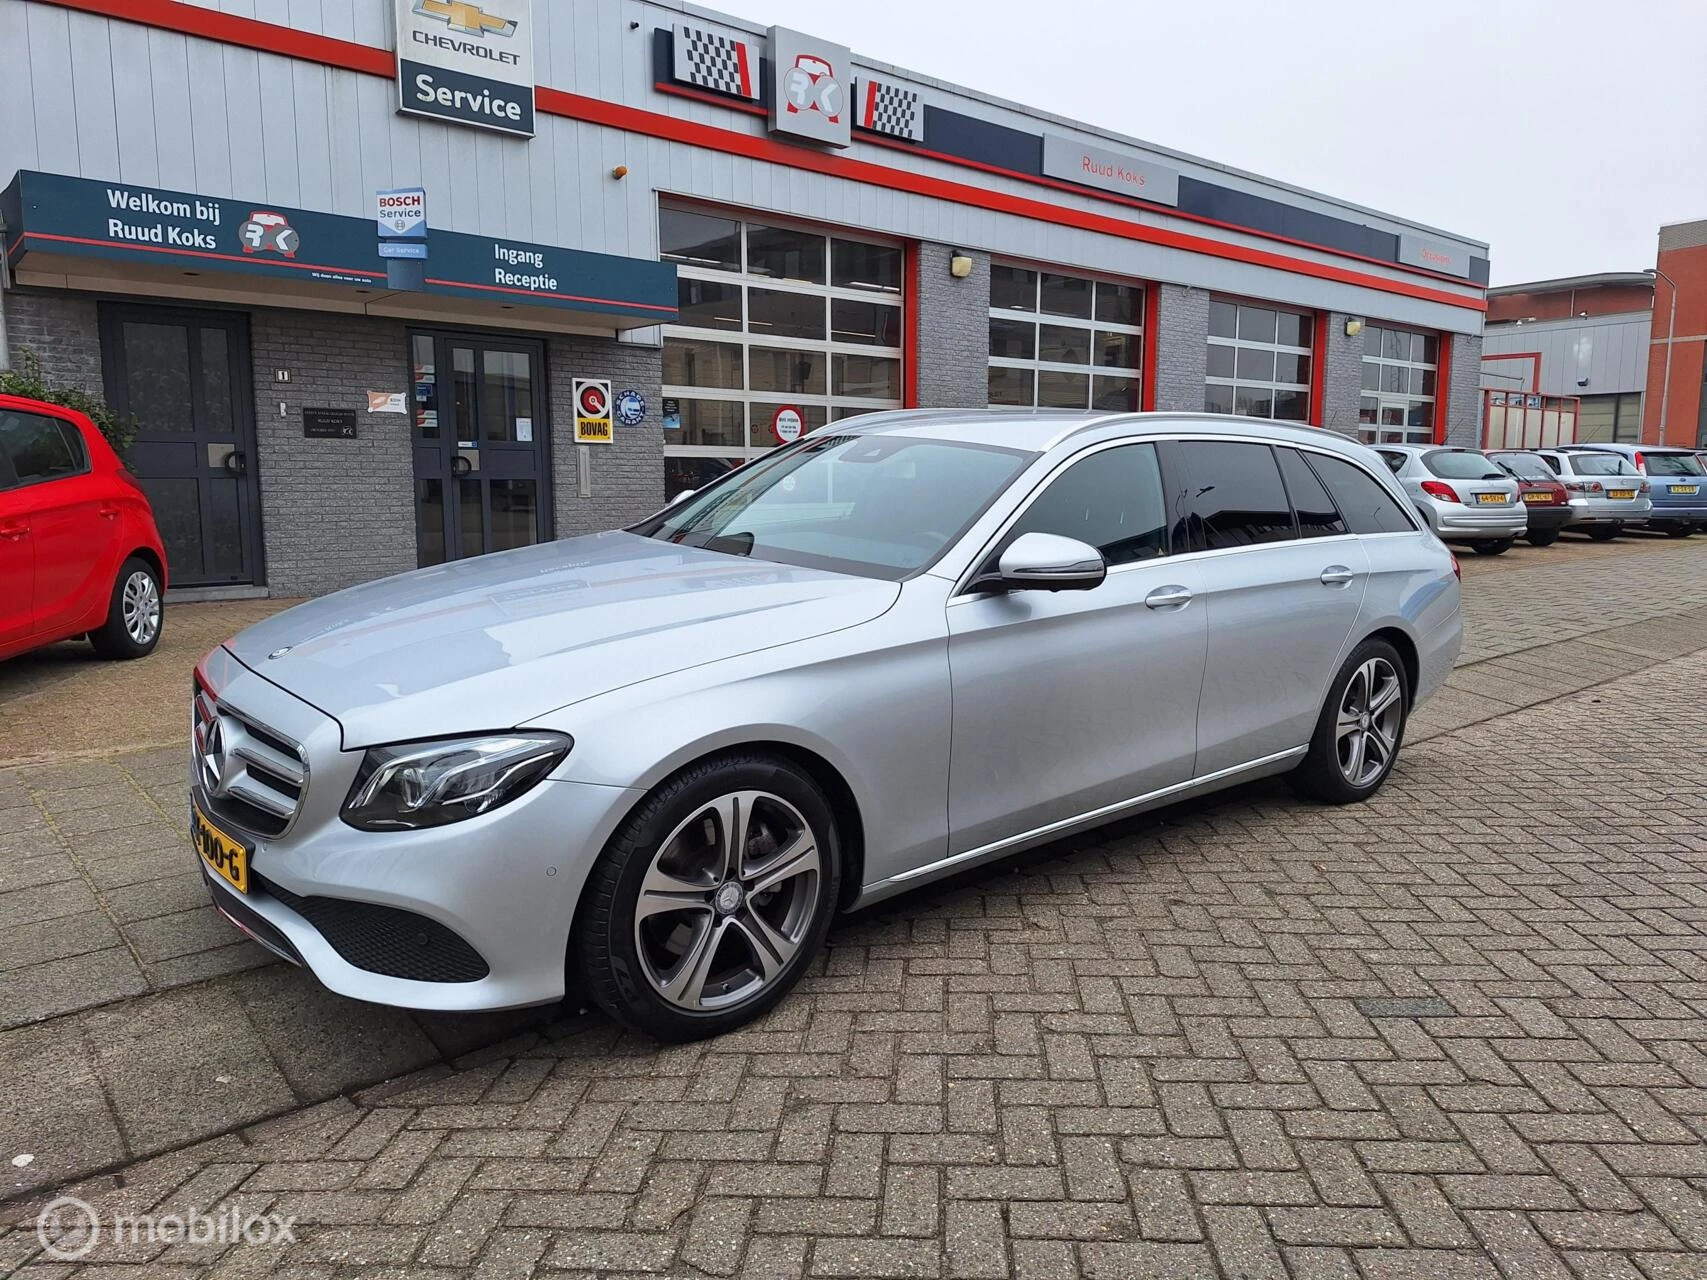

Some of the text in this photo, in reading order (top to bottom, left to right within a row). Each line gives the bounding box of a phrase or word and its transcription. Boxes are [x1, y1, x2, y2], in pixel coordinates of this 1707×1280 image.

[412, 30, 520, 65] CHEVROLET
[415, 73, 521, 120] Service
[1082, 155, 1146, 186] Ruud Koks
[106, 189, 220, 226] Welkom bij
[379, 195, 421, 207] BOSCH
[379, 208, 421, 218] Service
[108, 218, 217, 249] Ruud Koks
[494, 243, 543, 269] Ingang
[494, 268, 558, 291] Receptie
[616, 391, 645, 408] SCHADE
[580, 421, 608, 436] BOVAG
